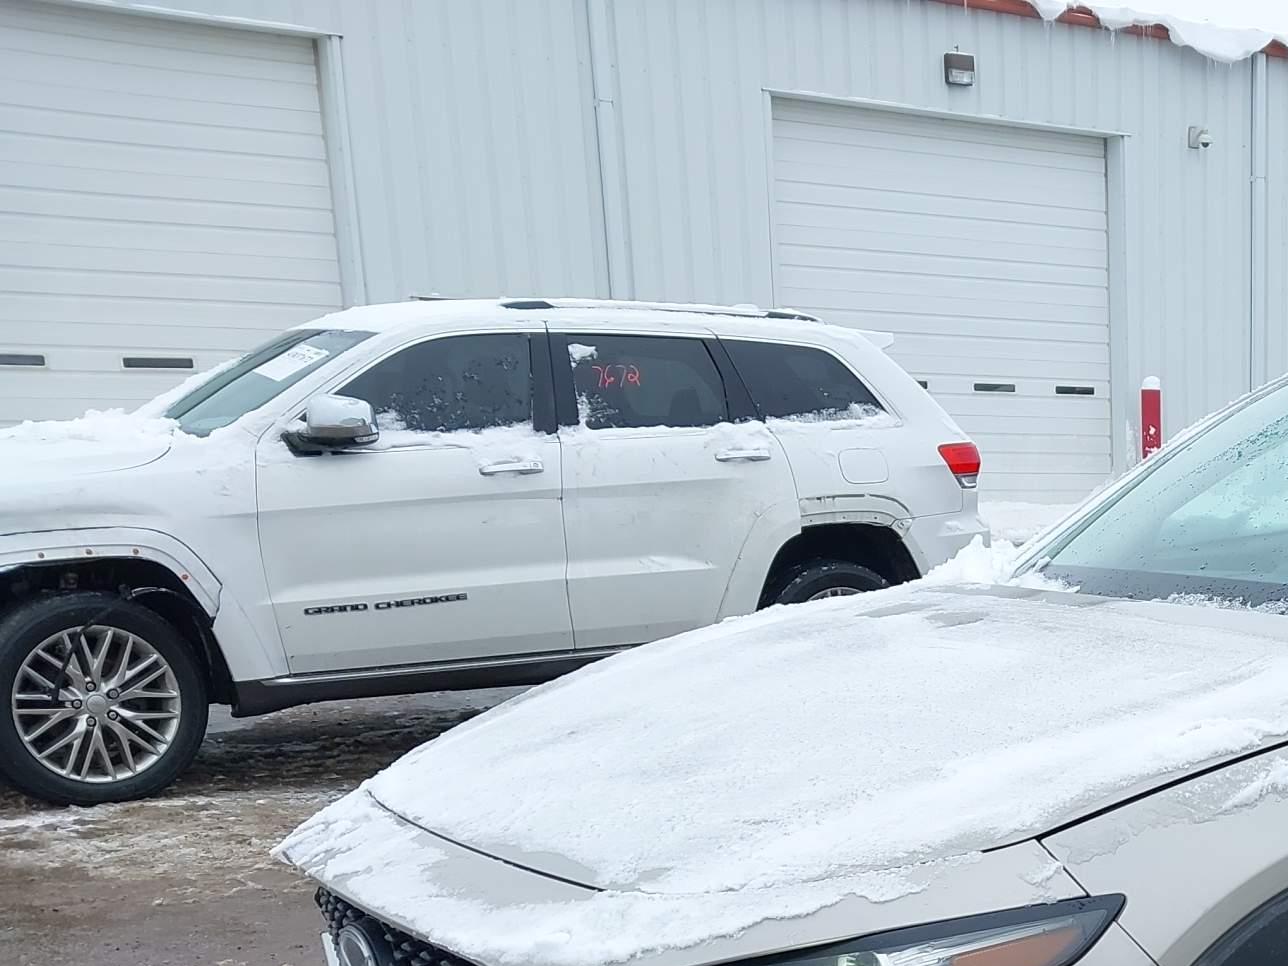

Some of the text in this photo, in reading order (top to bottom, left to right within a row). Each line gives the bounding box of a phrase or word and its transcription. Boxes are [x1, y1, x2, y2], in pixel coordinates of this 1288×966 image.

[592, 364, 640, 388] 7672
[304, 593, 468, 616] GRAND CHEROKEE
